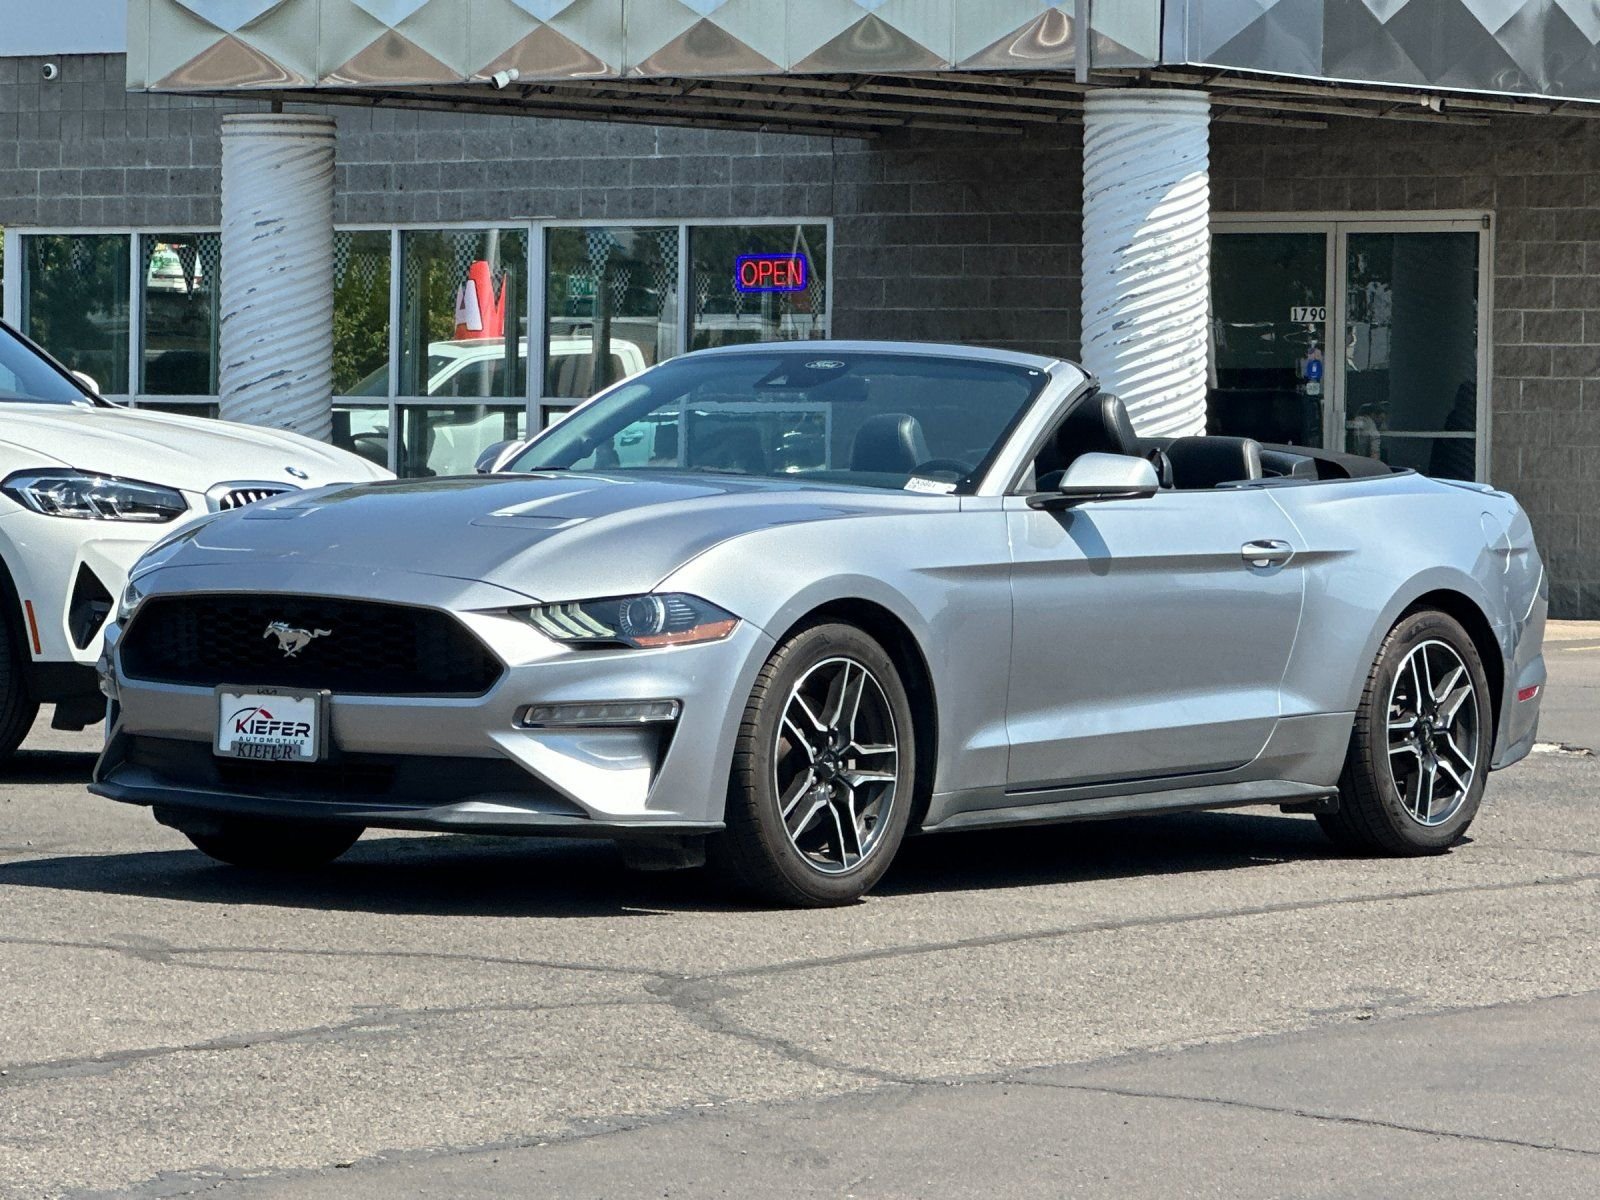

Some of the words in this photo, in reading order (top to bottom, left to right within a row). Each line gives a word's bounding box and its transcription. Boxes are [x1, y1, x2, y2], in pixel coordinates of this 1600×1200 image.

[741, 260, 803, 286] OPEN
[1293, 307, 1326, 321] 1790
[235, 718, 311, 738] KIEFER
[238, 736, 306, 745] AUTOMOTIVE
[237, 742, 293, 760] KIEFER
